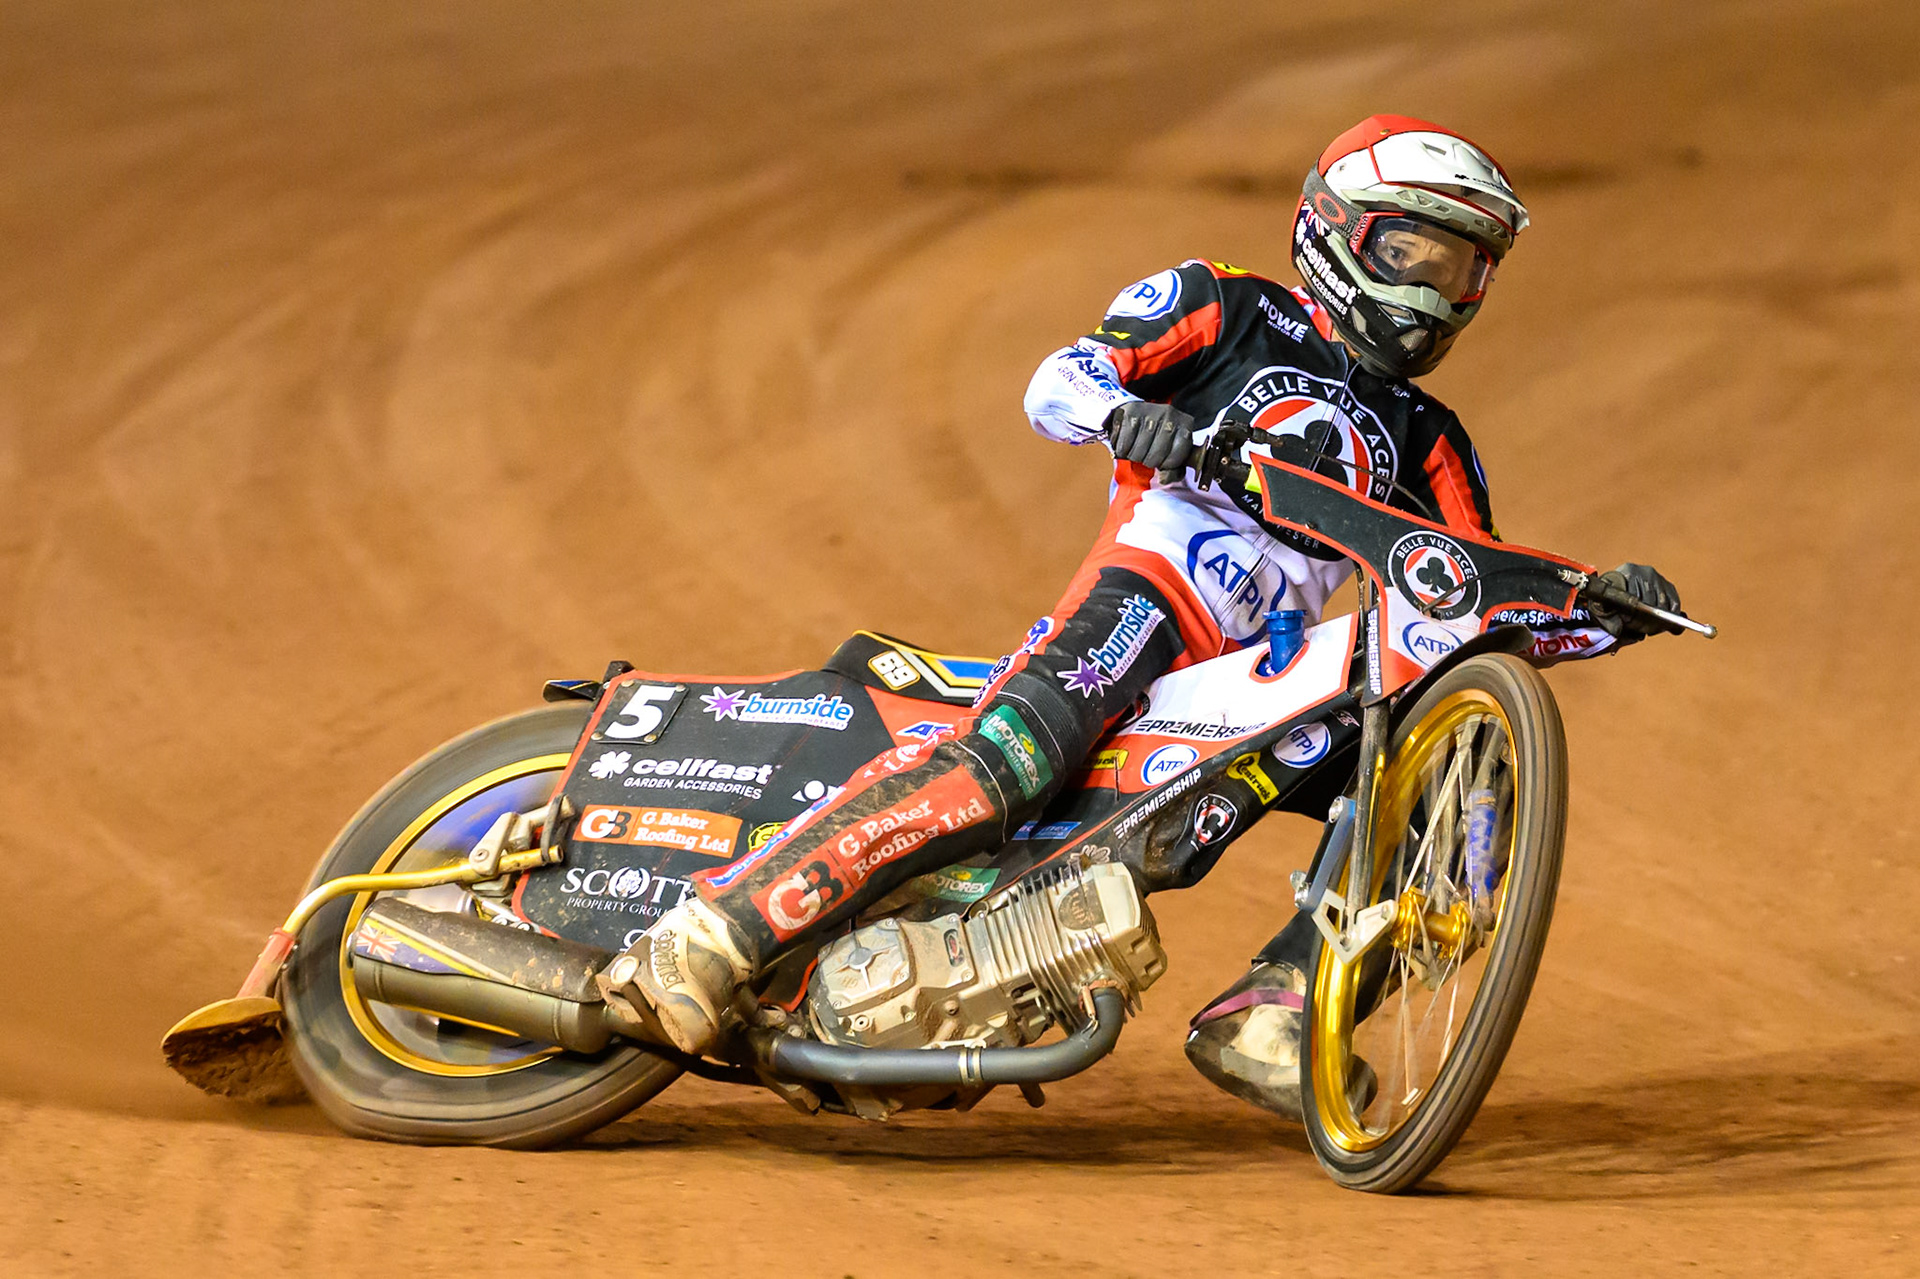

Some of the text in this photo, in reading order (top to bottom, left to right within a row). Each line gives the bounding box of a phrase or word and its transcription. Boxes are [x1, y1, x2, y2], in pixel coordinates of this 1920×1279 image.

[1302, 238, 1357, 305] cellfast
[1258, 293, 1309, 339] ROWE
[1311, 275, 1348, 315] ACCESSORIES
[1267, 320, 1291, 337] MOTOR
[1237, 376, 1390, 497] BELLE VUE ACES
[1396, 536, 1426, 560] BELLE
[1429, 536, 1453, 553] VUE
[1203, 552, 1264, 623] ATPI
[1090, 594, 1158, 672] burnside
[1367, 608, 1382, 696] PREMIERSHIP
[604, 684, 678, 739] 5
[745, 694, 851, 721] burnside
[1135, 719, 1267, 738] PREMIERSHIP
[632, 758, 774, 785] cellfast
[987, 714, 1040, 789] MOTOREX
[1151, 759, 1189, 773] ATPI
[623, 777, 763, 800] GARDEN ACCESSORIES
[1231, 755, 1272, 801] Rentruck
[1113, 767, 1202, 839] PREMIERSHIP
[633, 827, 731, 854] Roofing Ltd
[851, 797, 987, 881] Roofing Ltd
[560, 866, 694, 907] SCOTT
[566, 897, 669, 918] PROPERTY GROU
